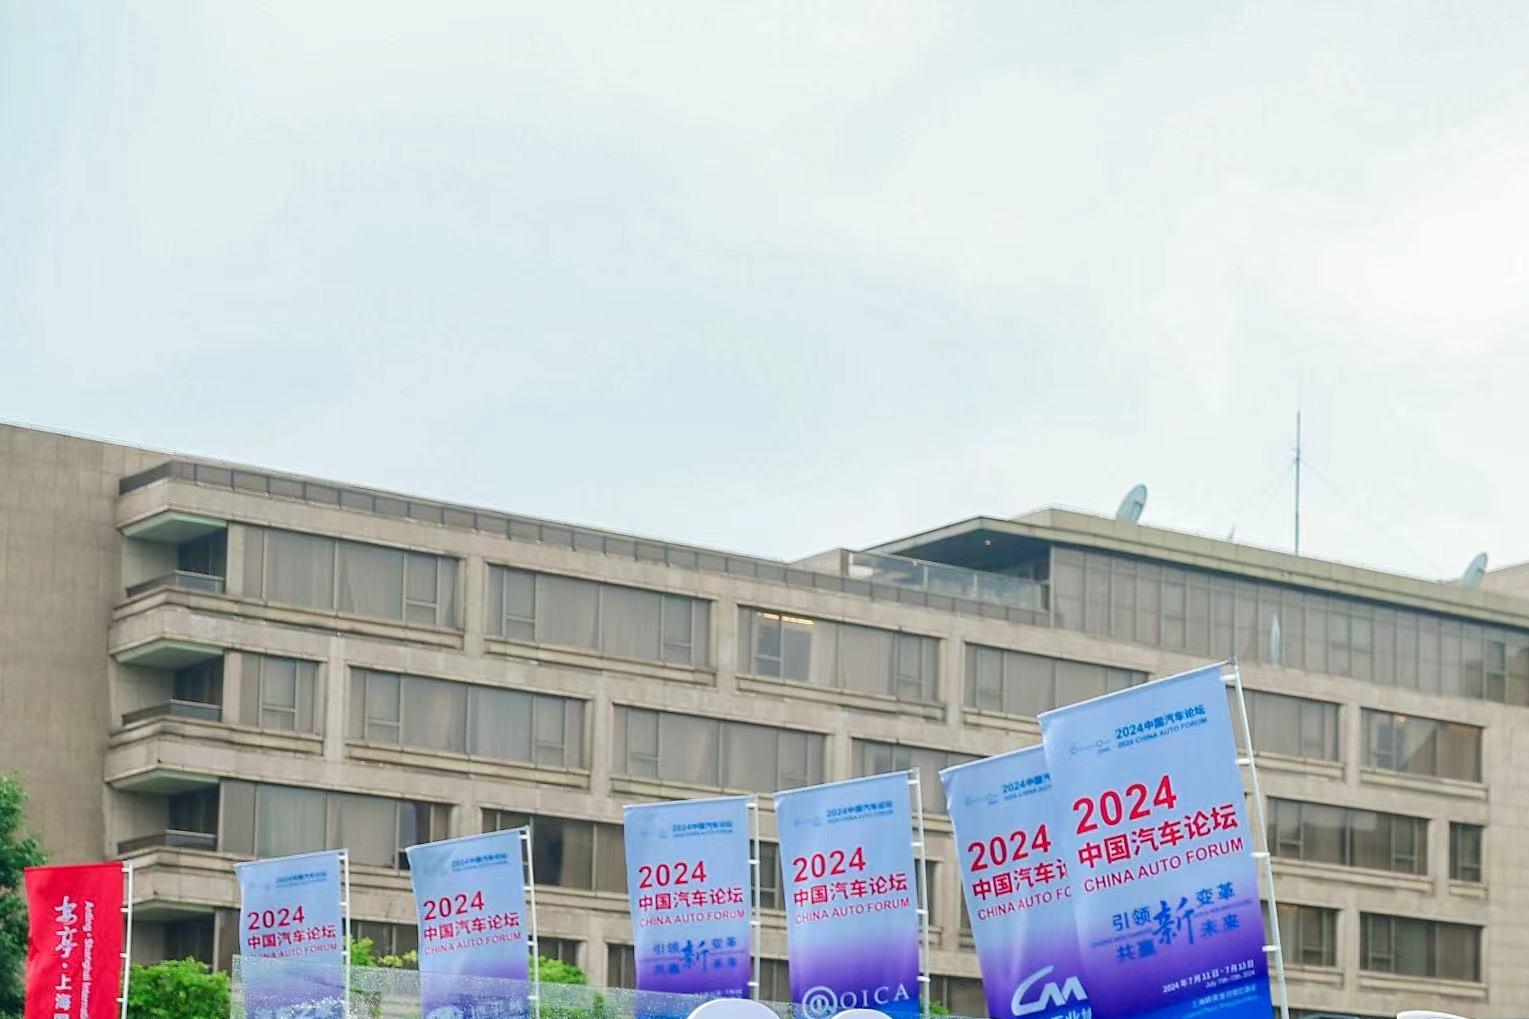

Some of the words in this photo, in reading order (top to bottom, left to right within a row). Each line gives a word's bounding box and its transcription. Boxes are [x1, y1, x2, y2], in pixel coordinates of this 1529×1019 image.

[1072, 775, 1177, 835] 2024
[968, 824, 1051, 872] 2024
[1078, 804, 1238, 868] 中国汽车论坛
[638, 861, 707, 889] 2024
[793, 846, 866, 883] 2024
[1084, 869, 1134, 893] CHINA
[1138, 855, 1182, 879] AUTO
[1186, 837, 1244, 865] FORUM
[638, 887, 744, 912] 中国汽车论坛
[794, 873, 908, 907] 中国汽车论坛
[247, 905, 305, 931] 2024
[423, 890, 485, 921] 2024
[640, 915, 672, 928] CHINA
[674, 911, 704, 923] AUTO
[707, 908, 746, 921] FORUM
[795, 909, 829, 925] CHINA
[831, 904, 865, 918] AUTO
[867, 898, 910, 913] FORUM
[978, 903, 1015, 921] CHINA
[1018, 890, 1053, 909] AUTO
[1112, 905, 1152, 932] 引领
[247, 924, 336, 950] 中国汽车论坛
[424, 912, 520, 941] 中国汽车论坛
[424, 942, 456, 956] CHINA
[457, 937, 483, 951] AUTO
[840, 983, 910, 1009] OICA
